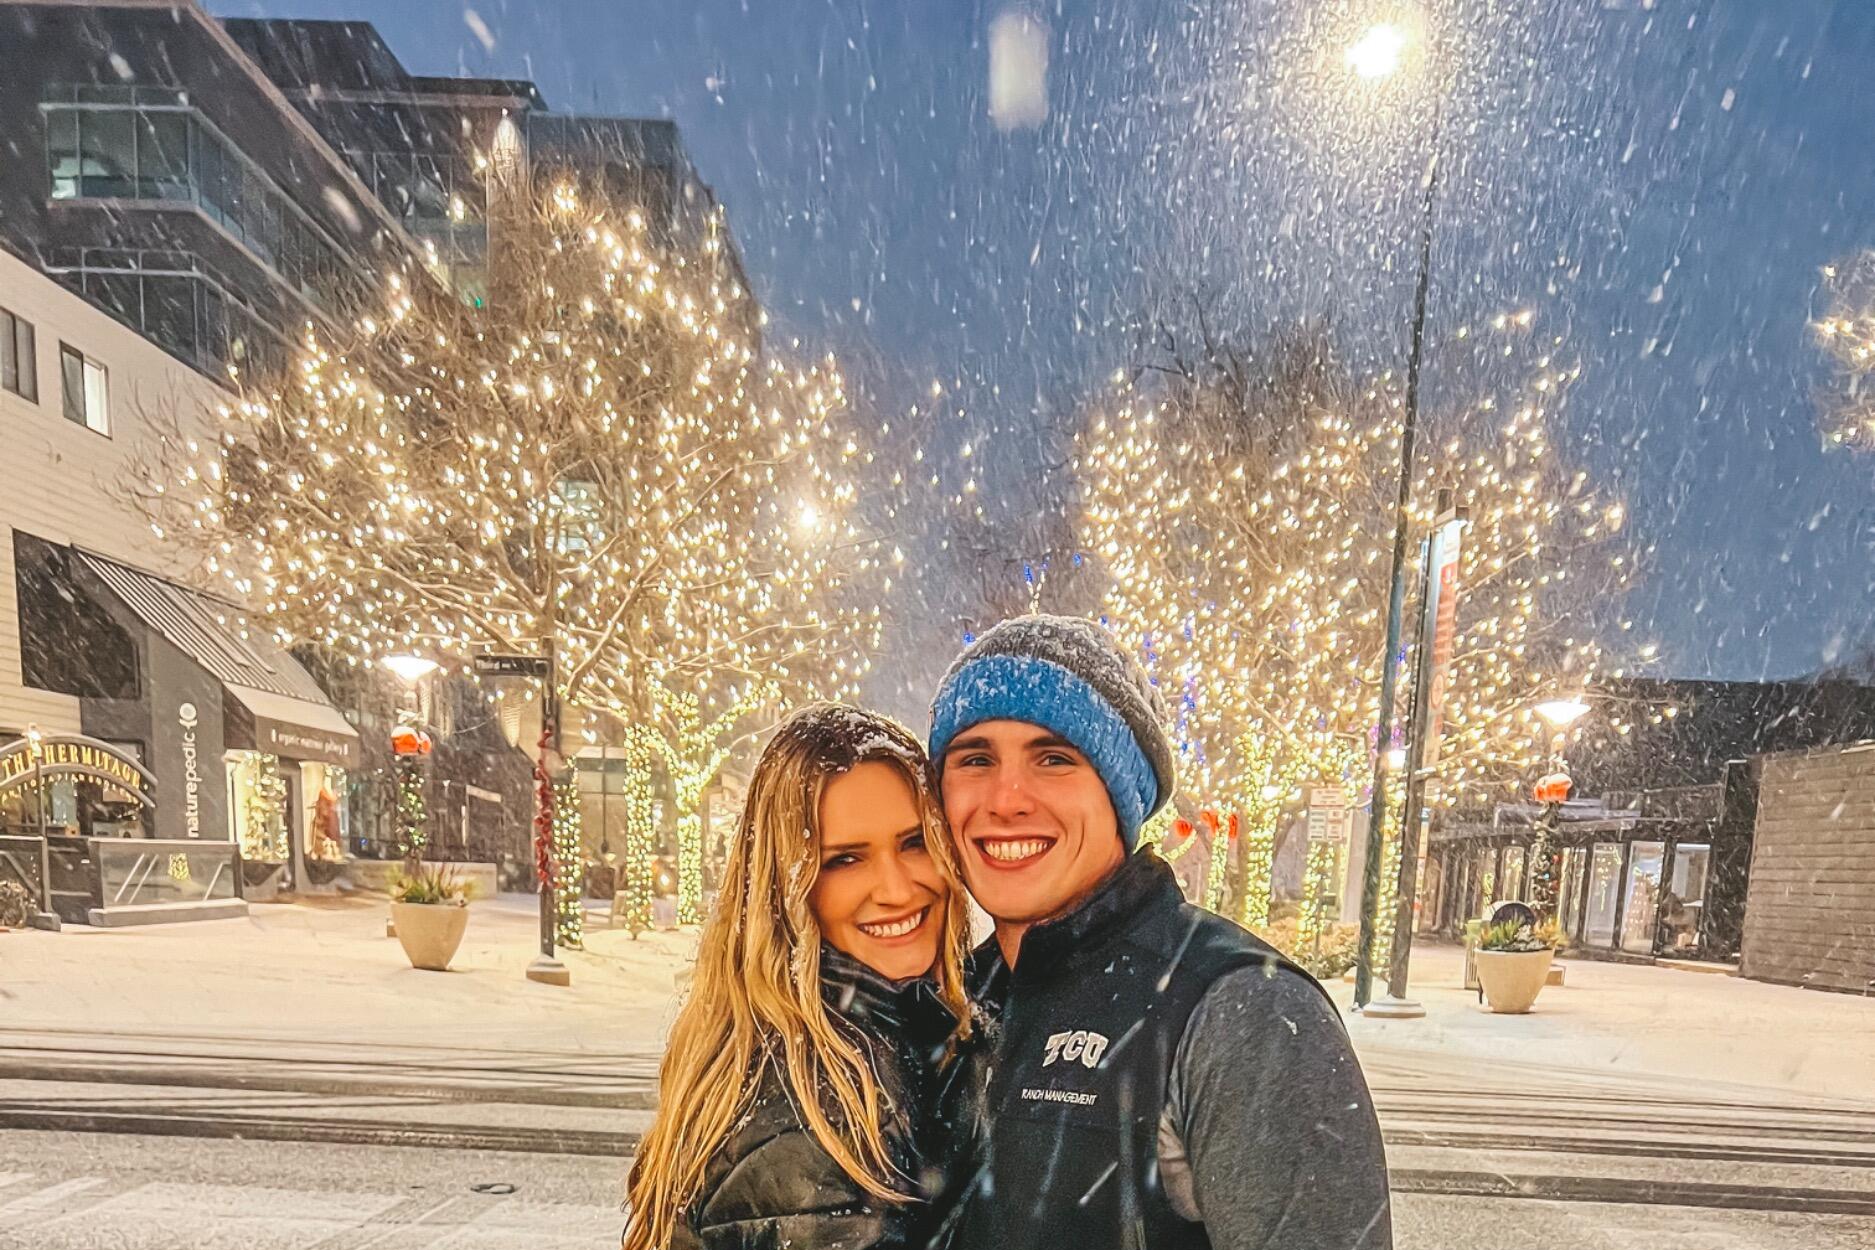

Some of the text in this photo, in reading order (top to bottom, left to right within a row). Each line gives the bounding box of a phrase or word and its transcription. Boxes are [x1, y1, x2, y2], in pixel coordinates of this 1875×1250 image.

[2, 744, 141, 789] THE HERMITAGE
[182, 732, 202, 838] naturepedic
[1042, 1031, 1109, 1068] TCU
[1021, 1088, 1097, 1106] RANCH MANAGEMENT
